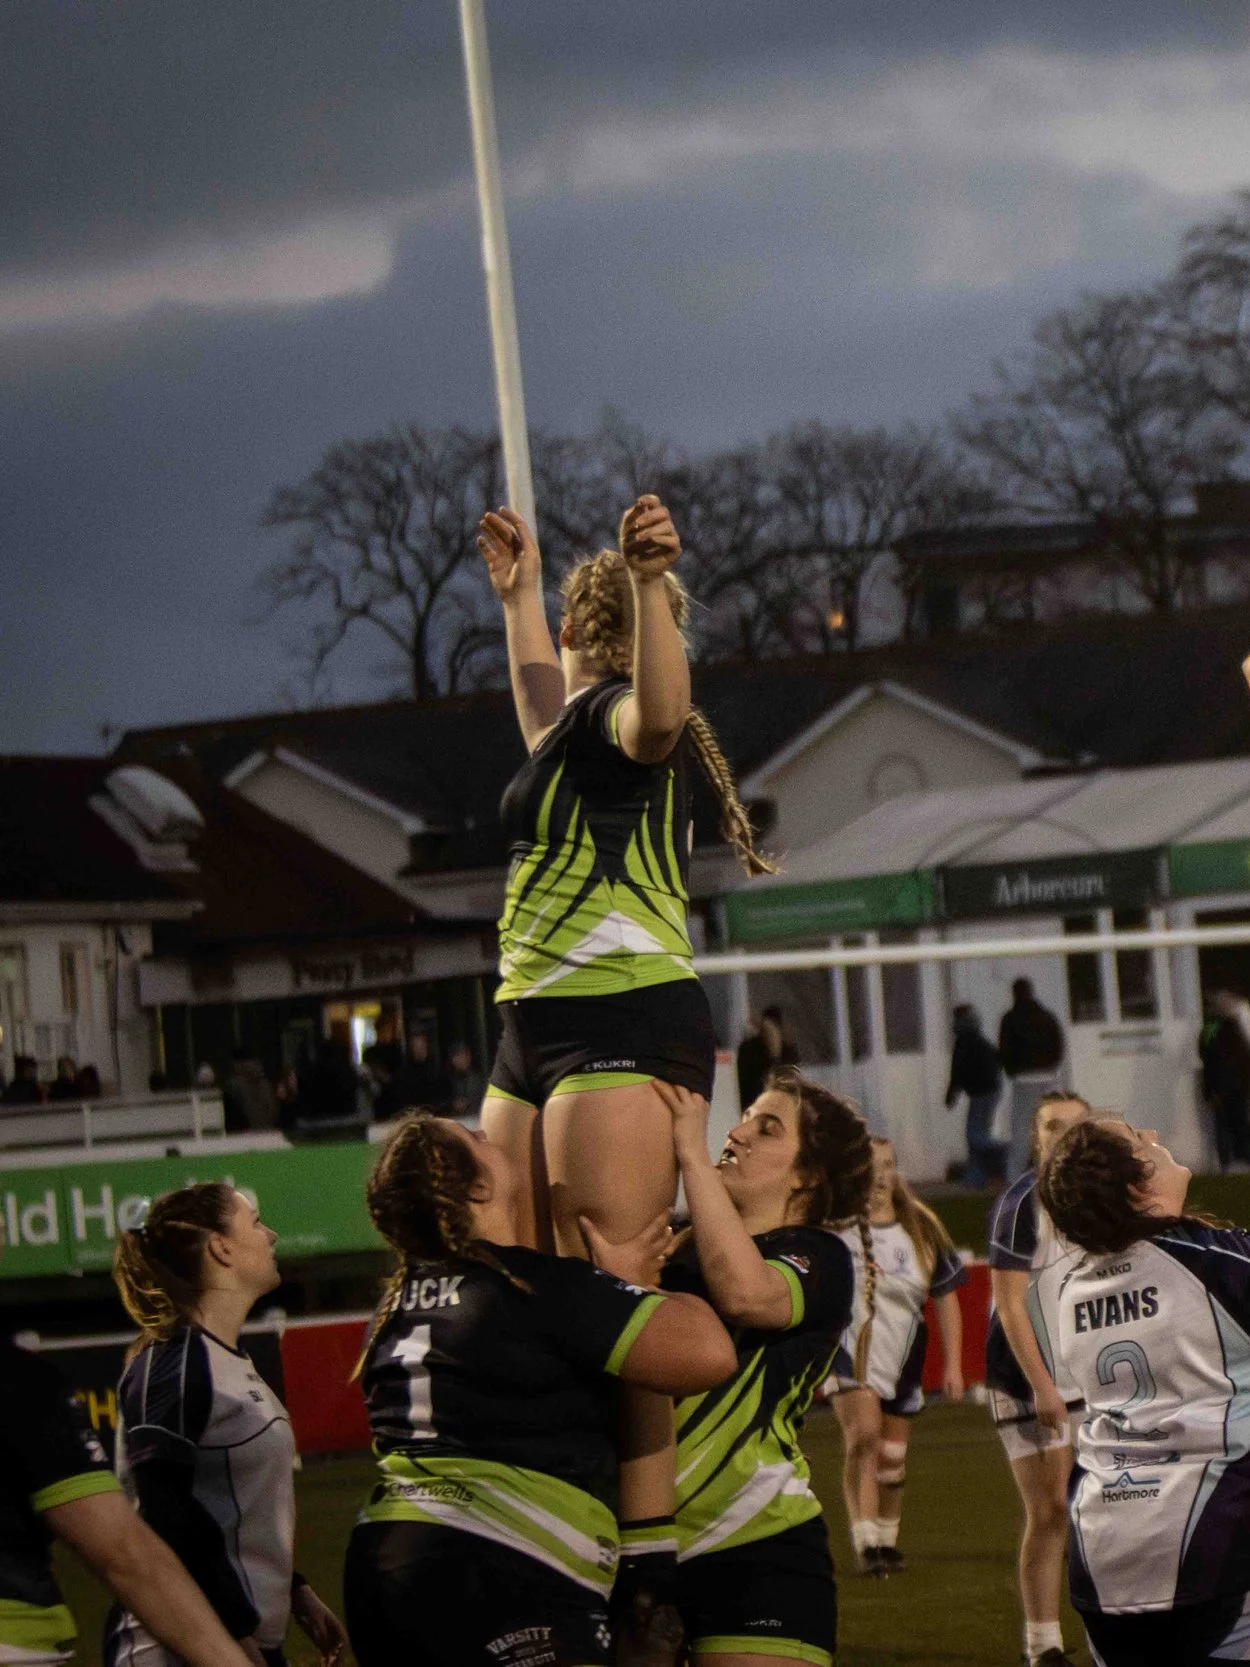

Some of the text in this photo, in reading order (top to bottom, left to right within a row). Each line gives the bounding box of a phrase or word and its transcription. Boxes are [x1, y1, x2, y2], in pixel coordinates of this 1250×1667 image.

[593, 1060, 636, 1070] KUKRI
[391, 1276, 465, 1312] UCK
[1074, 1286, 1159, 1334] EVANS
[391, 1324, 438, 1439] 1
[1096, 1340, 1169, 1442] 2
[1102, 1488, 1160, 1504] Hartmore
